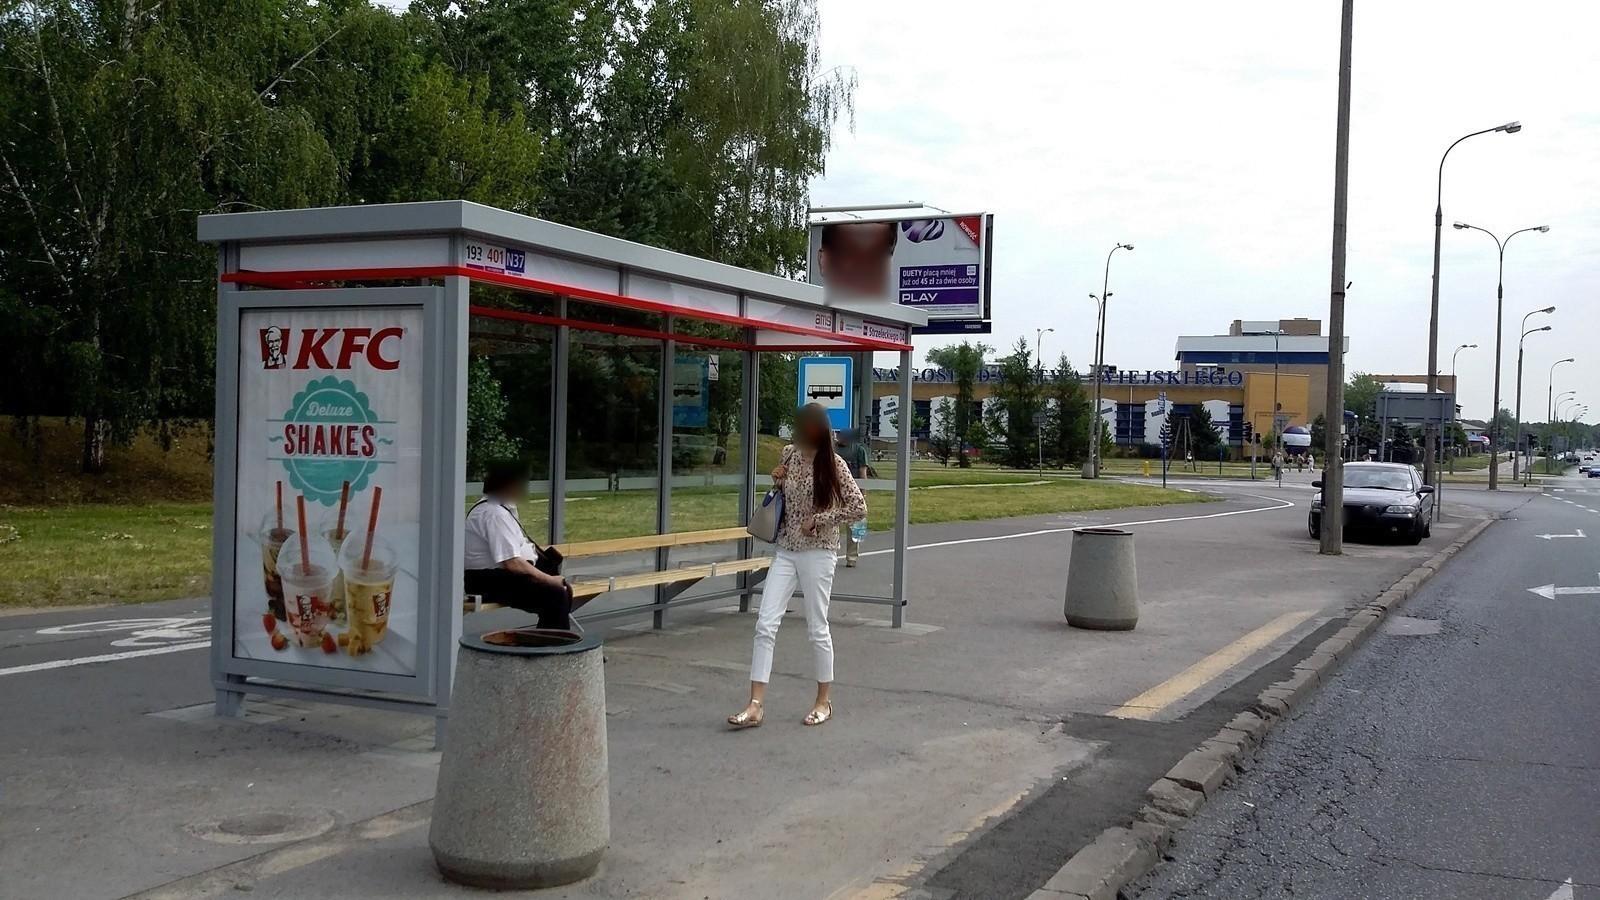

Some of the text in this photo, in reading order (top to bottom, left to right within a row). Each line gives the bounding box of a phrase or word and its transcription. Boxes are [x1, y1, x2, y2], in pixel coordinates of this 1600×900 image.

[466, 244, 524, 269] 193 401 N37
[902, 269, 922, 277] DUETY
[911, 278, 920, 286] od
[944, 277, 957, 285] dwie
[958, 276, 977, 286] osoby
[901, 292, 938, 302] PLAY
[815, 313, 832, 327] ams
[292, 327, 403, 370] KFC
[306, 402, 353, 417] Deluxe
[284, 423, 375, 457] SHAKES
